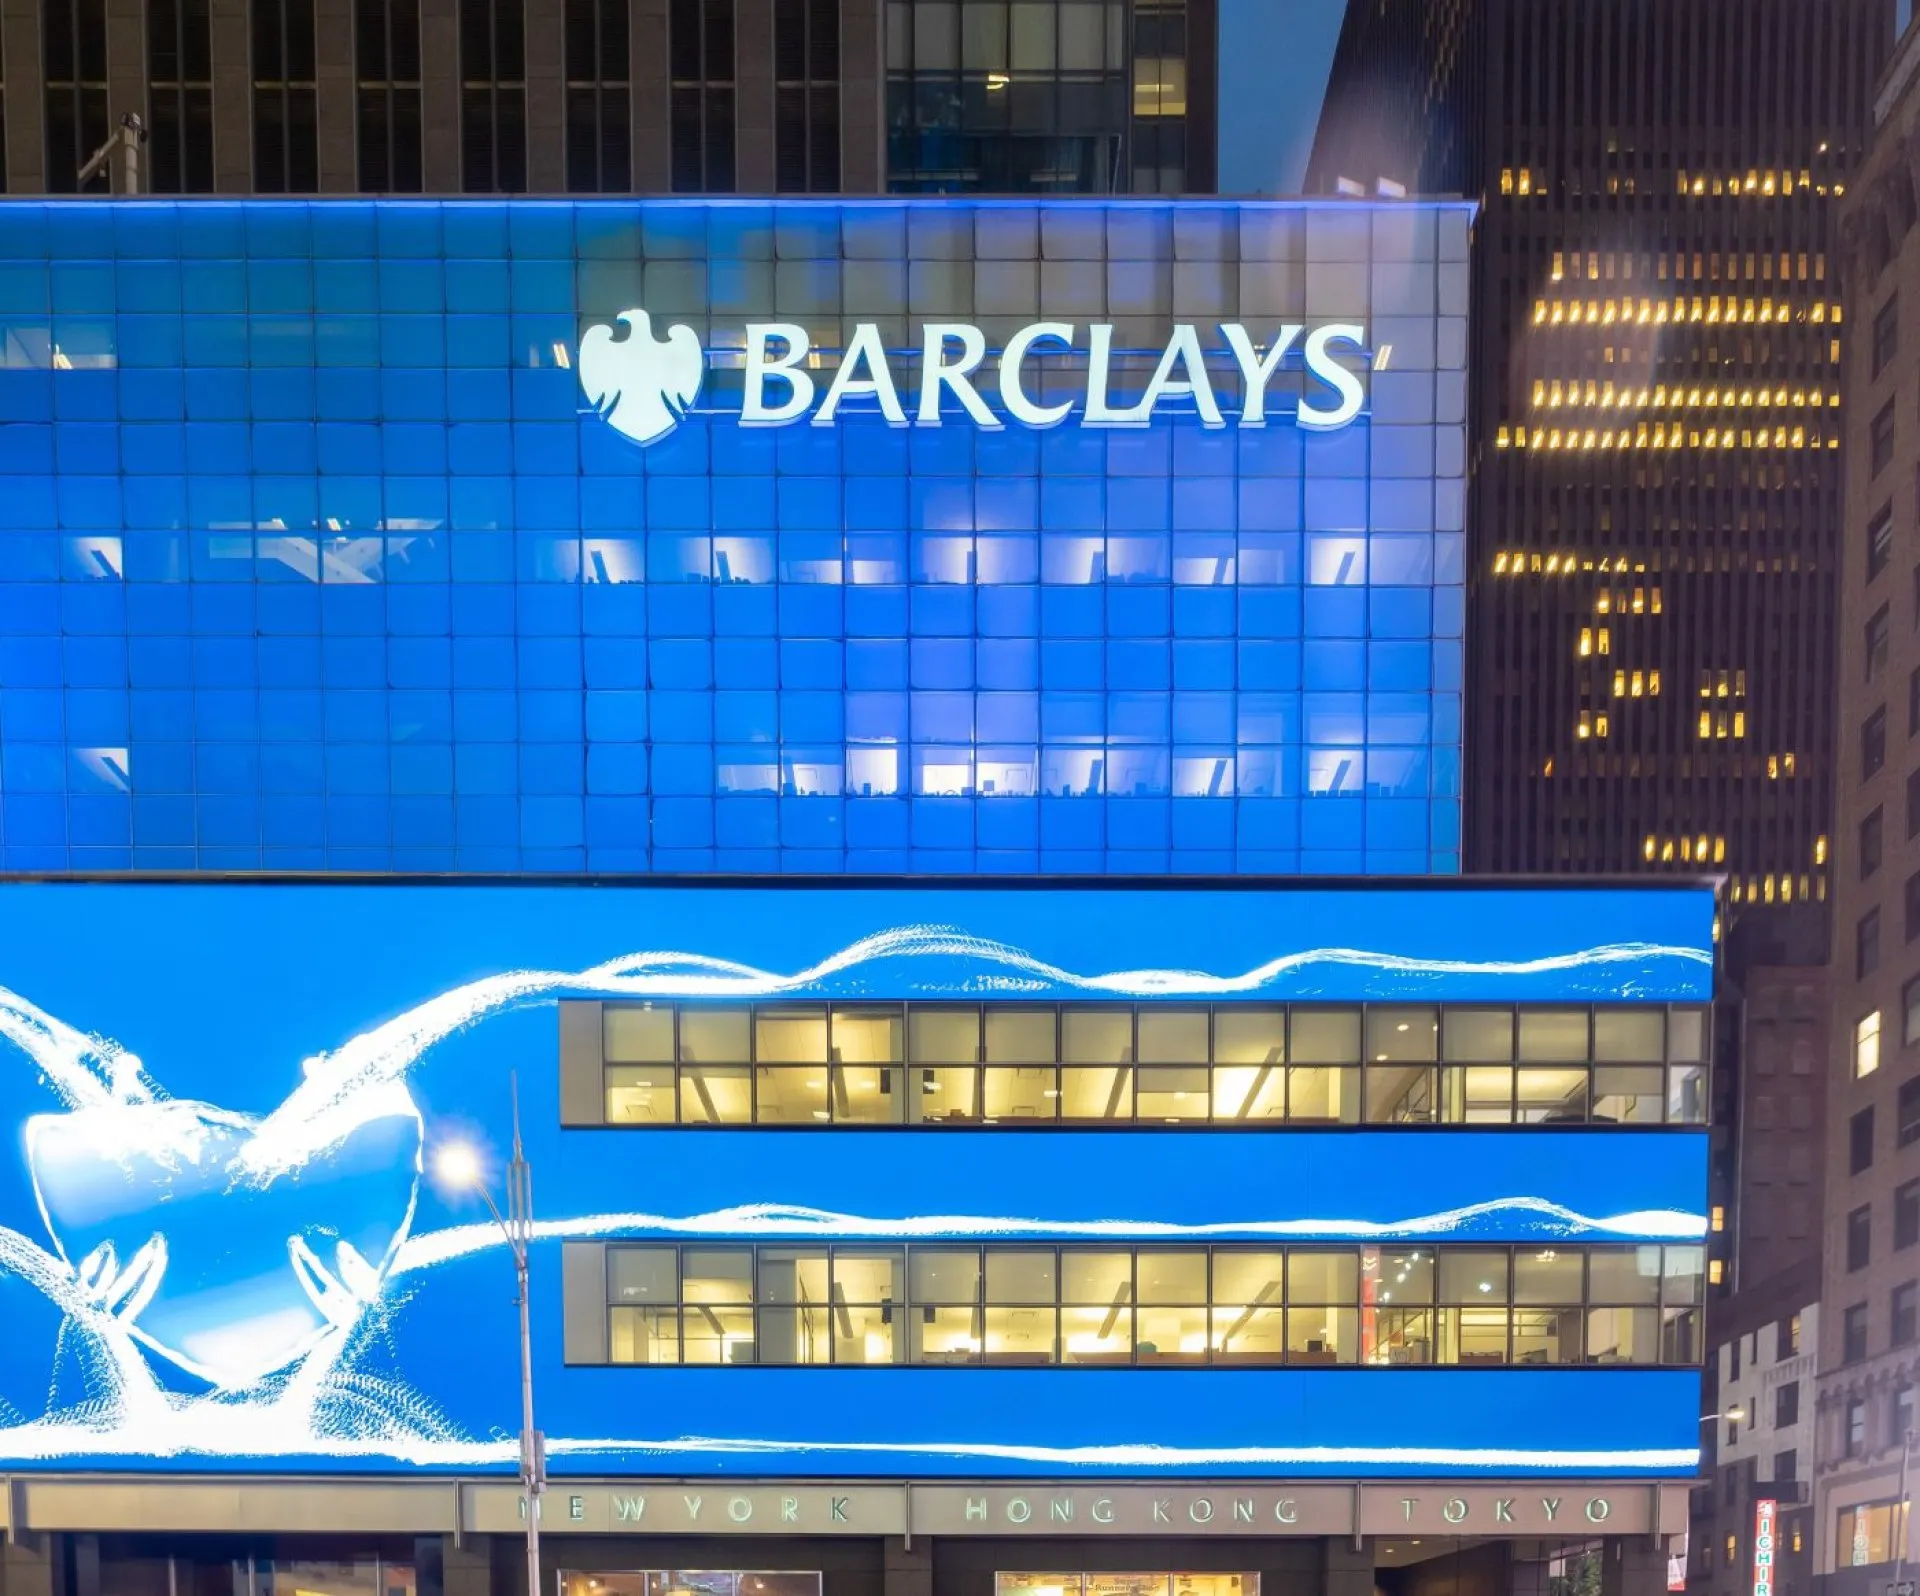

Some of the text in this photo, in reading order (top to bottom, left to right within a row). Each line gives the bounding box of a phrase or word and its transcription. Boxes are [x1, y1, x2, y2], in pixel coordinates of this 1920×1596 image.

[738, 322, 1366, 431] BARCLAYS
[683, 1495, 849, 1522] YORK
[965, 1496, 1298, 1523] HONG KONG
[1400, 1497, 1611, 1523] TOKYO
